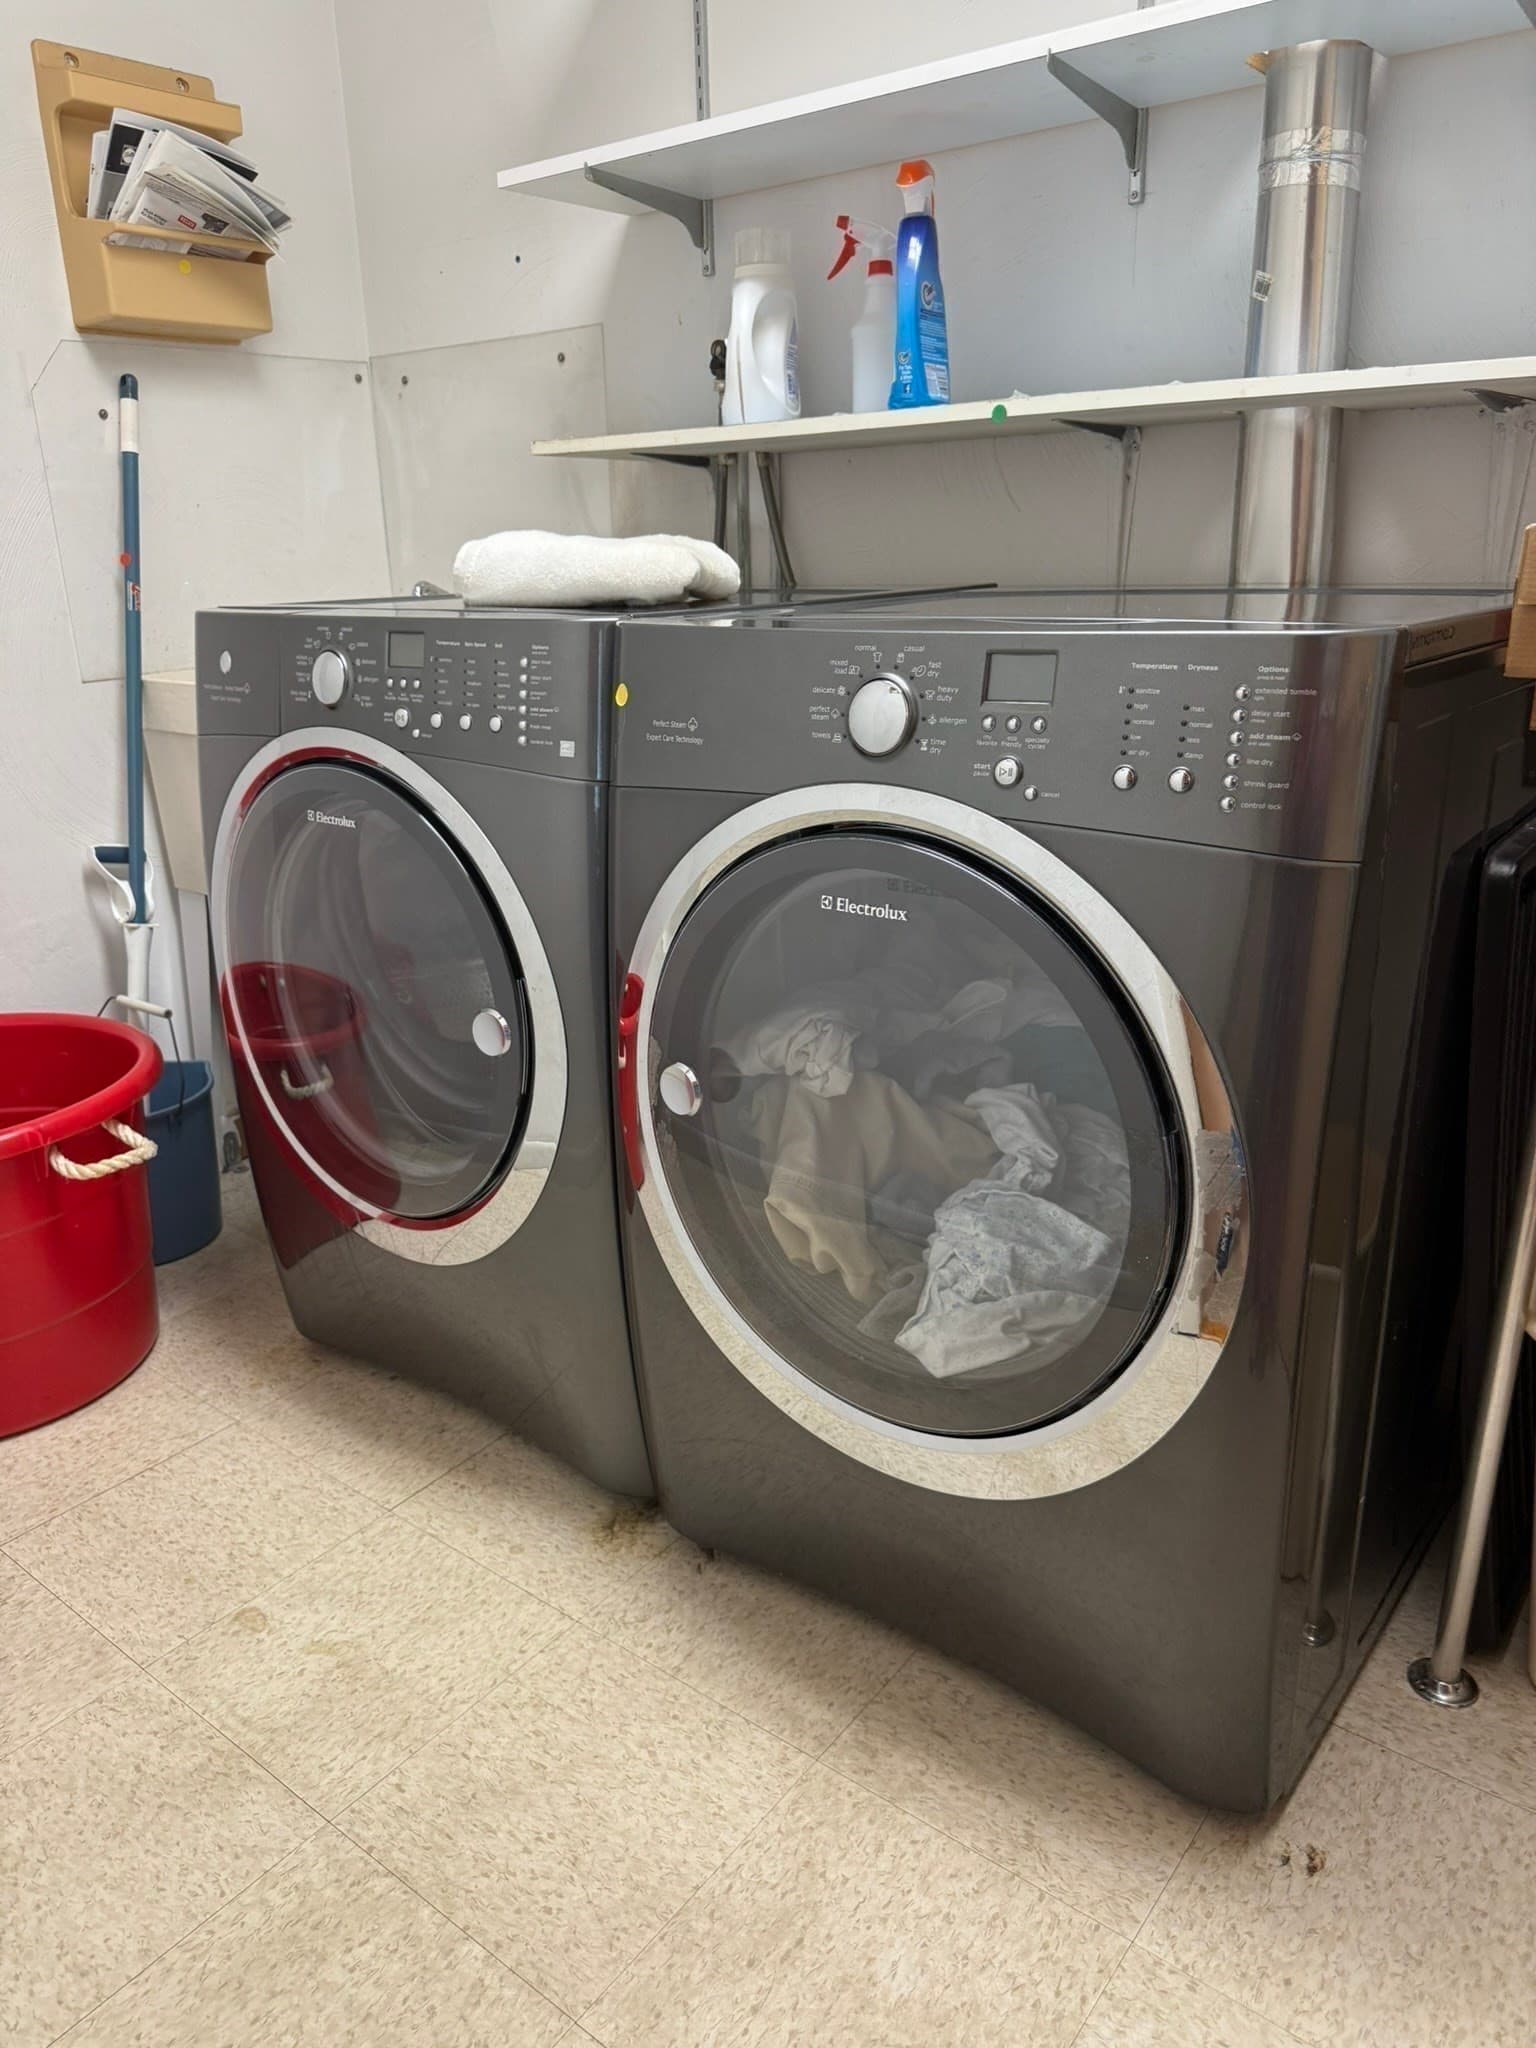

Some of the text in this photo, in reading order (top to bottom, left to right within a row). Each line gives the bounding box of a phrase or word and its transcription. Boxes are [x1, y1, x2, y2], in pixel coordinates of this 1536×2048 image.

[928, 661, 942, 669] fast
[1131, 662, 1178, 672] Temperature
[1187, 664, 1219, 672] Dryness
[1257, 665, 1290, 674] Options
[927, 670, 940, 678] dry
[937, 686, 959, 695] heavy
[1254, 687, 1318, 696] extended tumble
[936, 694, 953, 702] duty
[809, 705, 830, 714] perfect
[1134, 703, 1149, 711] high
[1251, 710, 1291, 718] delay start
[652, 719, 687, 729] Perfect Steam
[939, 717, 967, 725] allergen
[646, 732, 704, 745] Expert Care Technology
[812, 731, 831, 739] towels
[1249, 733, 1291, 742] add steam
[930, 738, 947, 746] time
[929, 747, 942, 755] dry
[1246, 758, 1274, 767] line dry
[1243, 780, 1290, 790] shrink guard
[1240, 802, 1281, 810] control lock
[316, 811, 356, 829] Electrolux
[836, 896, 908, 922] Electrolux
